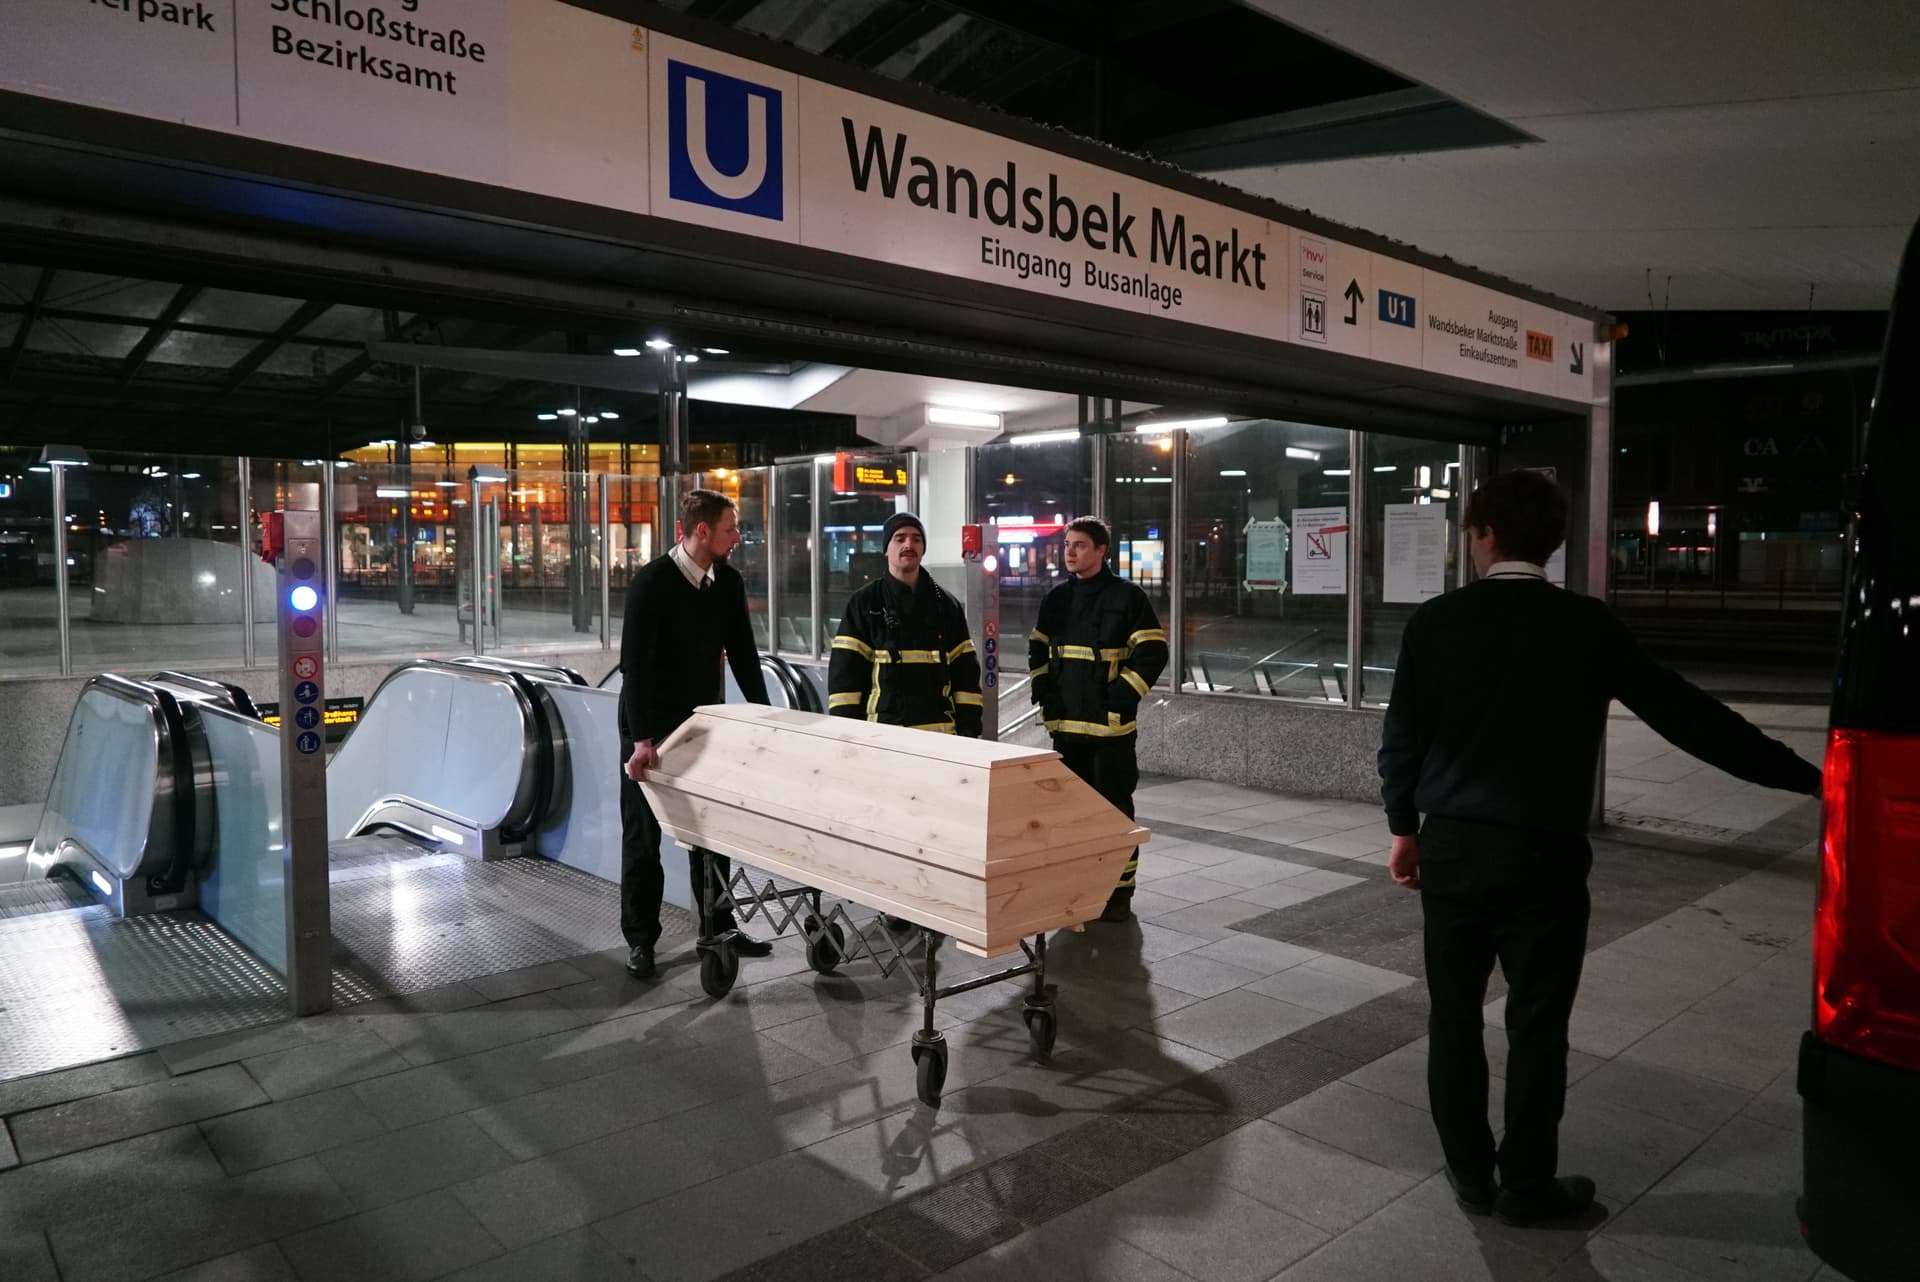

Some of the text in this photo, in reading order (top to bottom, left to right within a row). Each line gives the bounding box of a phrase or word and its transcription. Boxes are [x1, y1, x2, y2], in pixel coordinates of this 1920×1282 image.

[90, 0, 215, 32] rpark
[272, 25, 457, 95] Bezirksamt
[686, 75, 767, 199] U
[841, 116, 1266, 291] Wandsbek Markt
[981, 236, 1183, 308] Eingang Busanlage
[1303, 268, 1324, 282] Service
[1388, 295, 1407, 321] U1
[1488, 309, 1518, 333] Ausgang
[1428, 314, 1518, 350] Wandsbeker Marktstraße
[1527, 335, 1552, 358] TAXI
[1459, 343, 1518, 369] Einkaufszentrum
